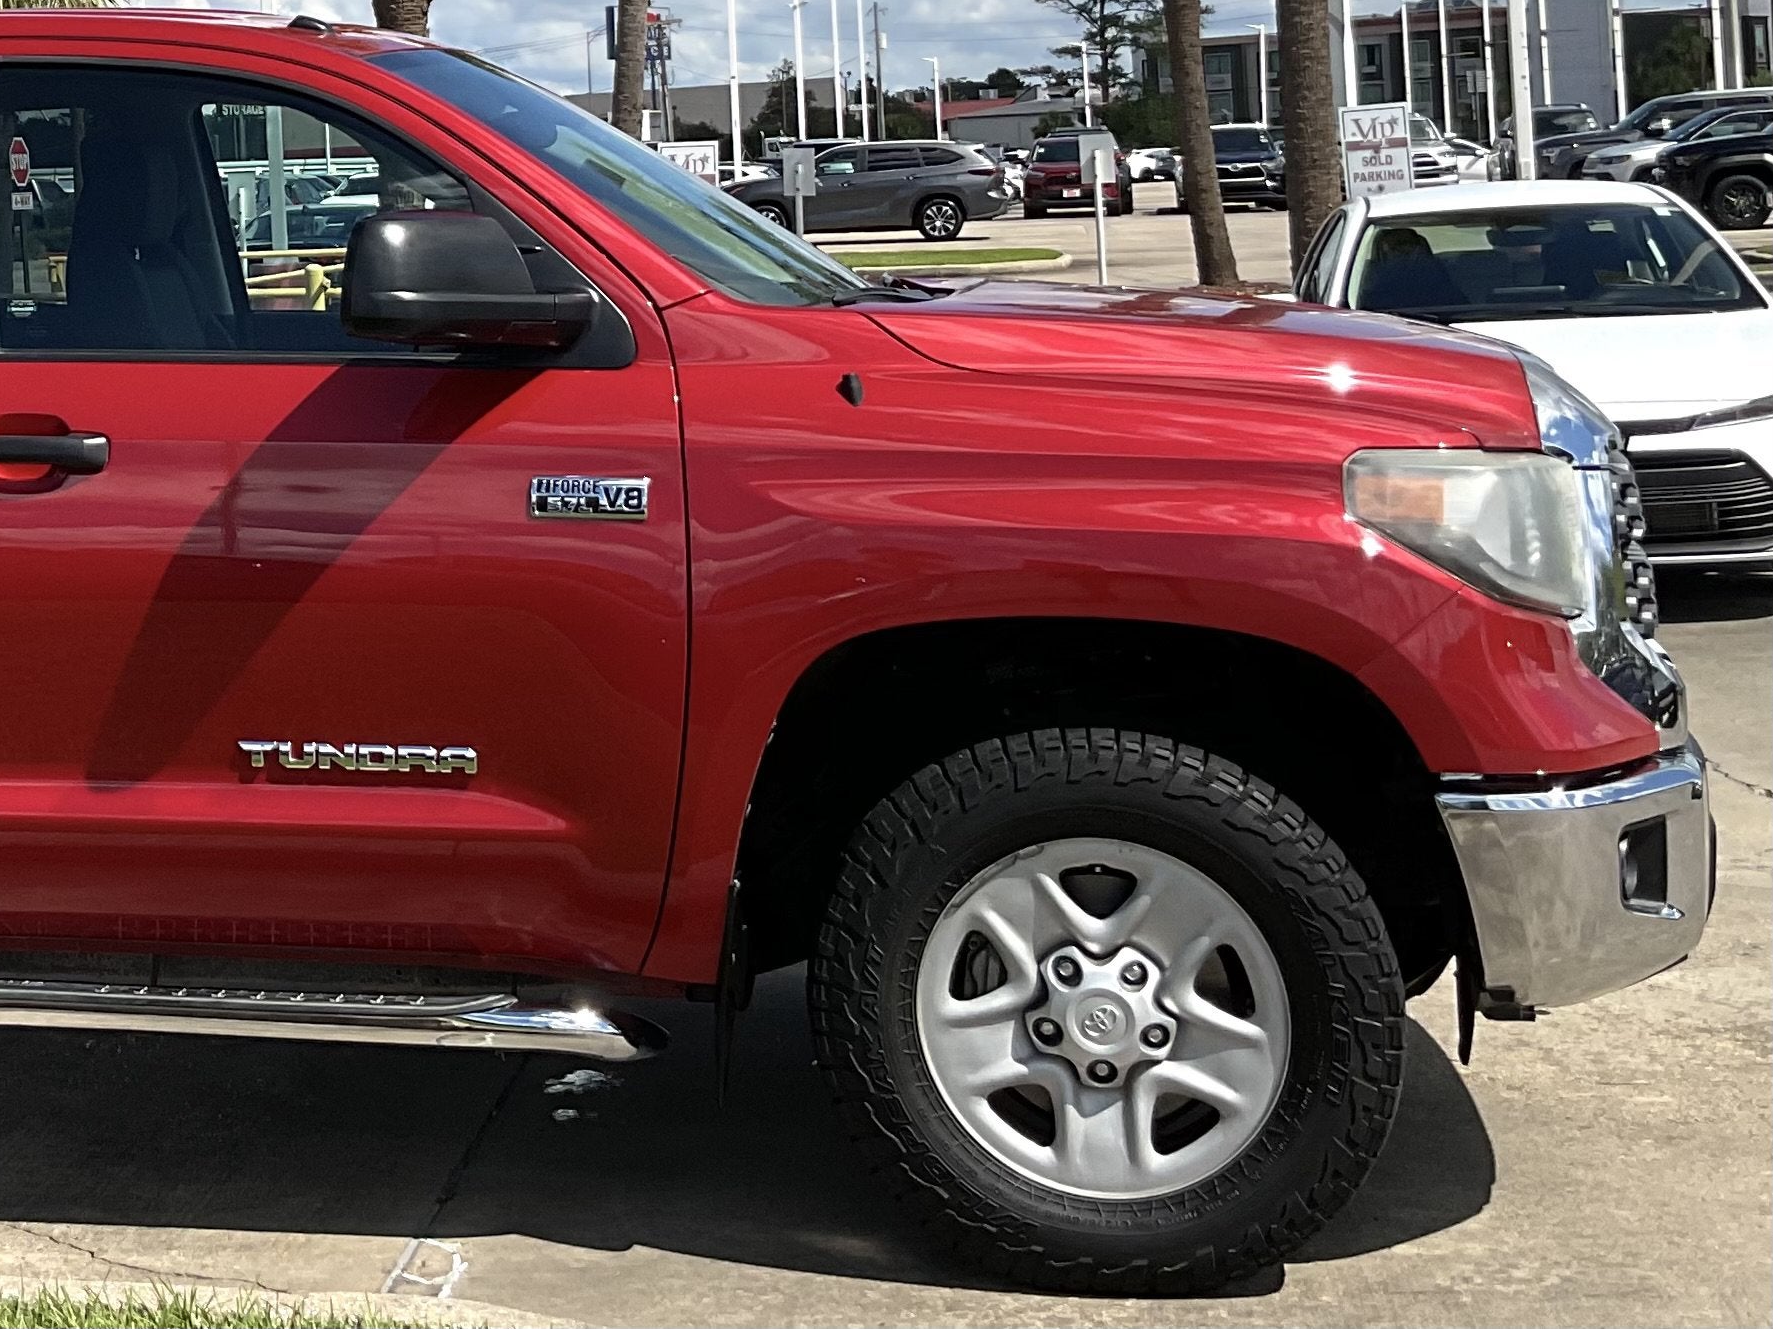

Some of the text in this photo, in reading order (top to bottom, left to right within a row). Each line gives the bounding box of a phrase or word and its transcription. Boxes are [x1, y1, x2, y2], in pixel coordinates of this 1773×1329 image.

[11, 155, 28, 170] STOP
[1362, 155, 1393, 167] SOLD
[1353, 169, 1404, 183] PARKING
[603, 486, 643, 510] V8
[237, 741, 478, 774] TUNDRA
